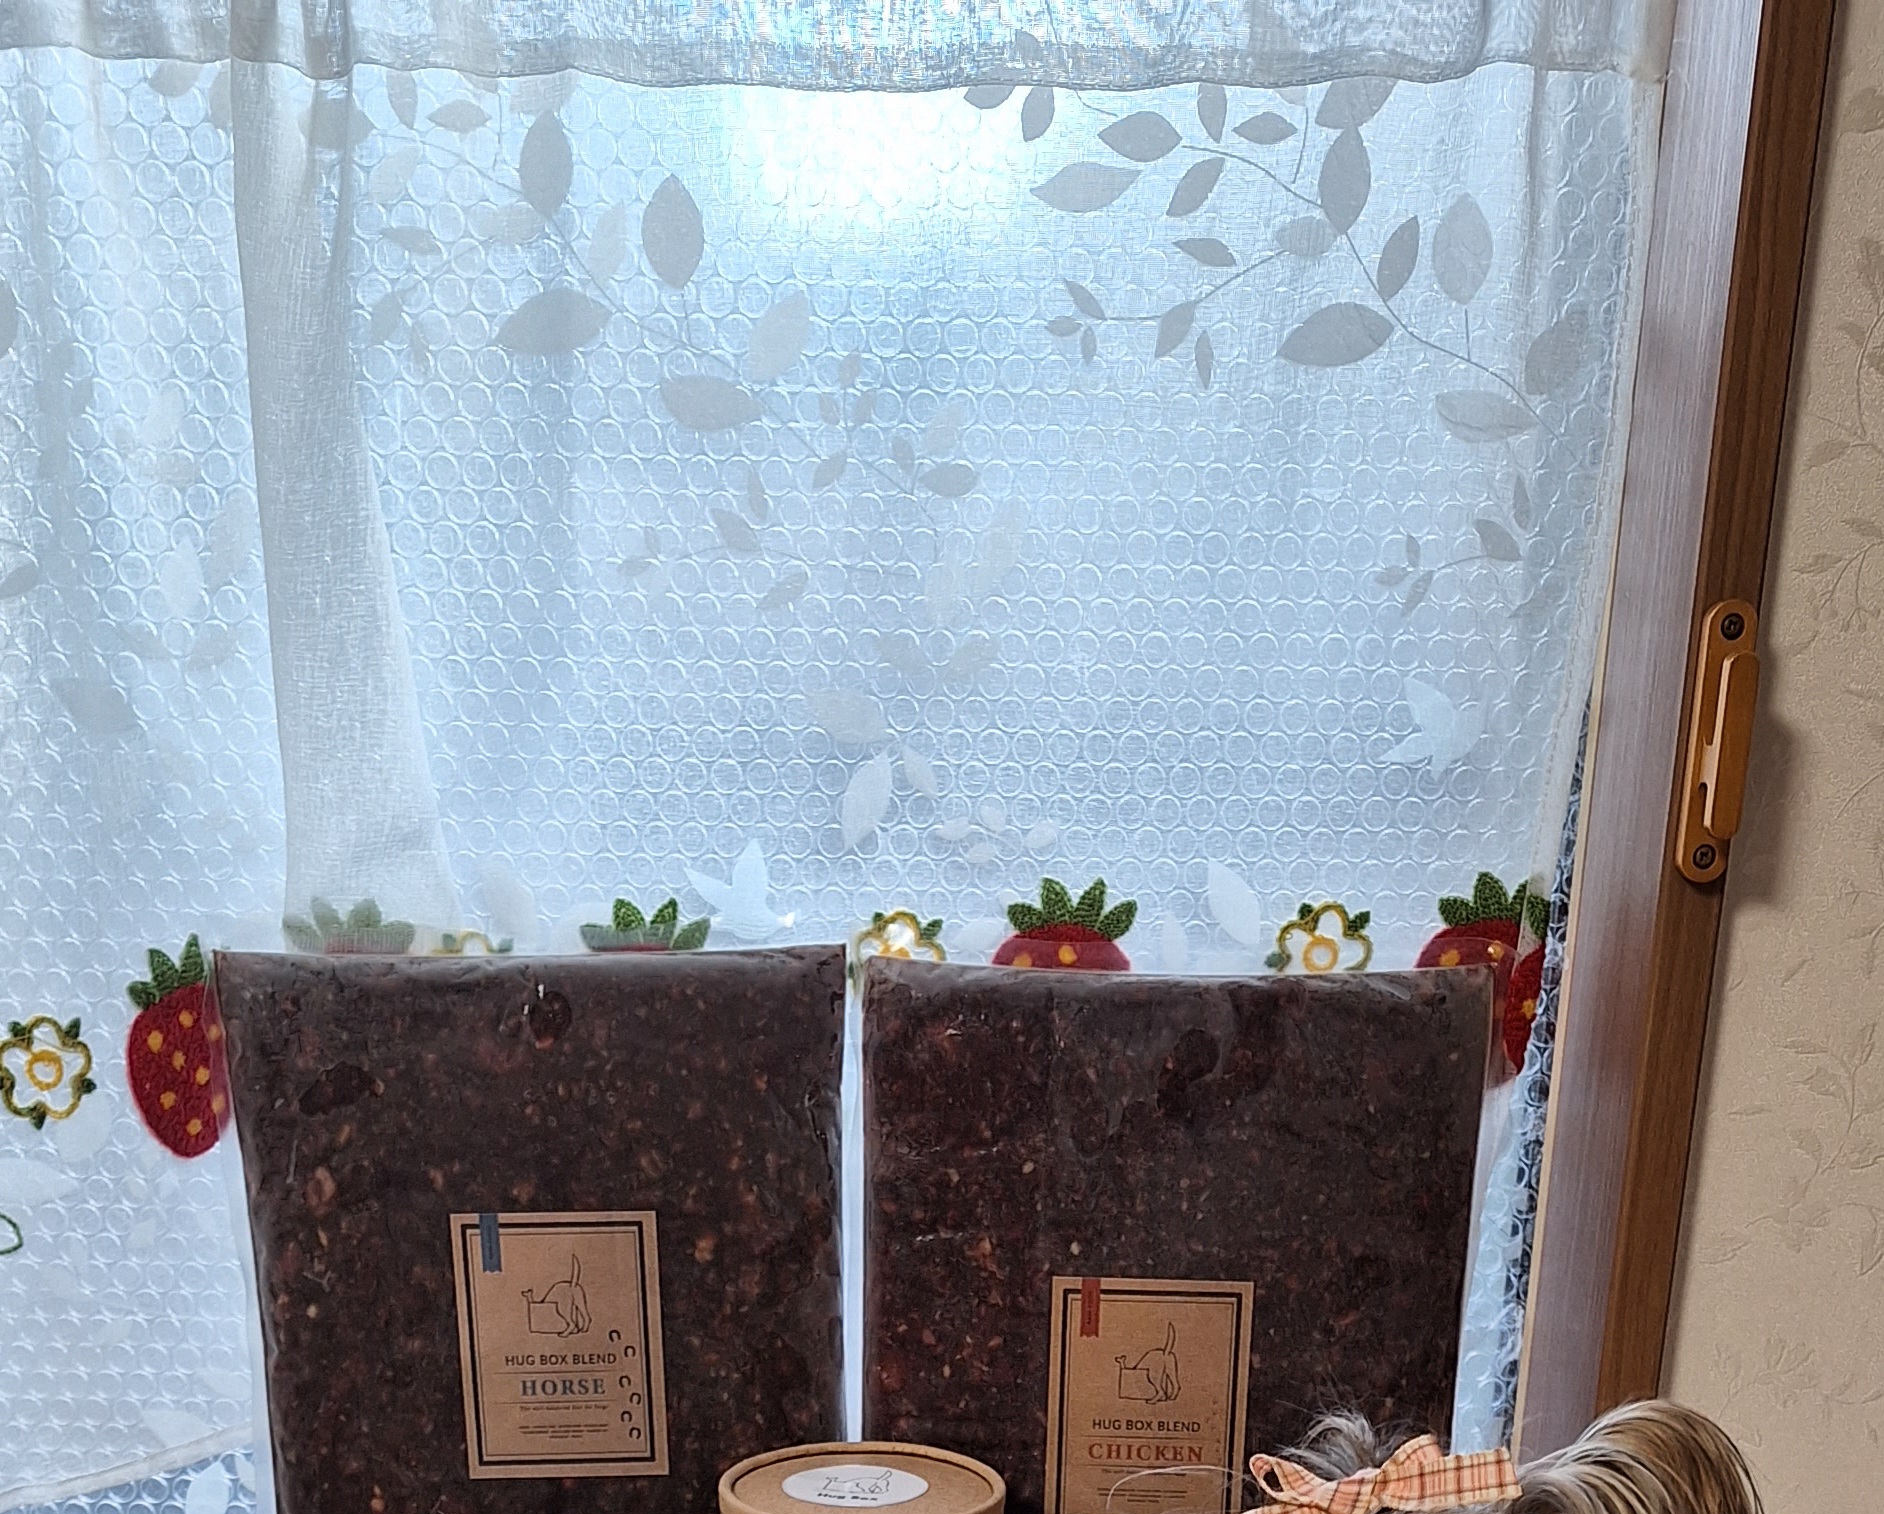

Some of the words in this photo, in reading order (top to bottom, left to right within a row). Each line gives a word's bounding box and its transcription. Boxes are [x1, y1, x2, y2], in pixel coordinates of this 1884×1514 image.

[505, 1354, 536, 1367] HUG
[539, 1353, 569, 1366] BOX
[572, 1352, 617, 1365] BLEND
[521, 1378, 606, 1397] HORSE
[1092, 1418, 1122, 1431] HUG
[1125, 1419, 1154, 1432] BOX
[1157, 1420, 1201, 1433] BLEND
[1088, 1443, 1203, 1462] CHICKEN
